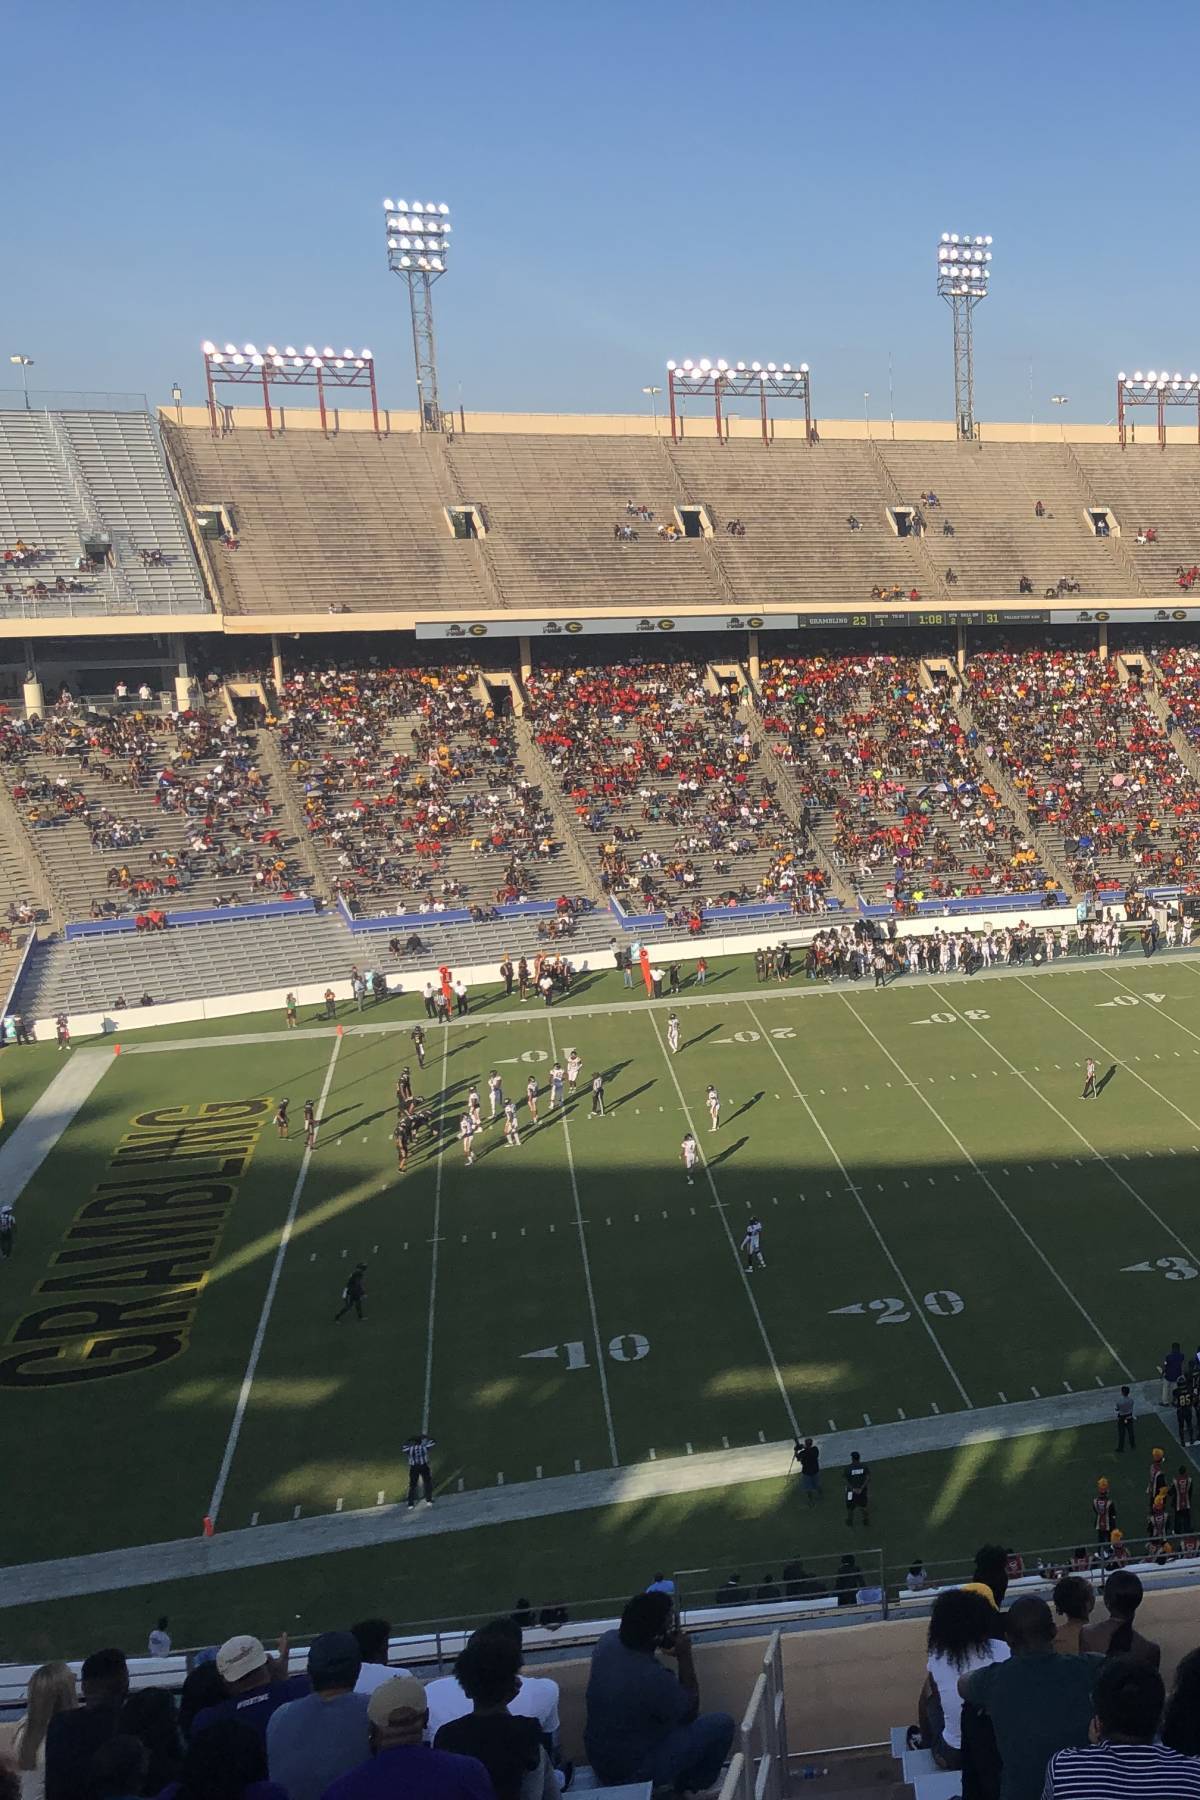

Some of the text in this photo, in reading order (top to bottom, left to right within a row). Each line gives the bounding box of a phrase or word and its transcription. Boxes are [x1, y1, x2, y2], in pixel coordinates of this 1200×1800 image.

[852, 616, 867, 626] 23
[919, 615, 942, 624] 1:08
[986, 614, 999, 623] 31
[1113, 993, 1166, 1006] 40
[930, 1009, 991, 1023] 30
[734, 1027, 797, 1042] 20
[0, 1097, 275, 1389] GRAMBLING
[868, 1290, 965, 1325] 20
[563, 1333, 650, 1370] 10
